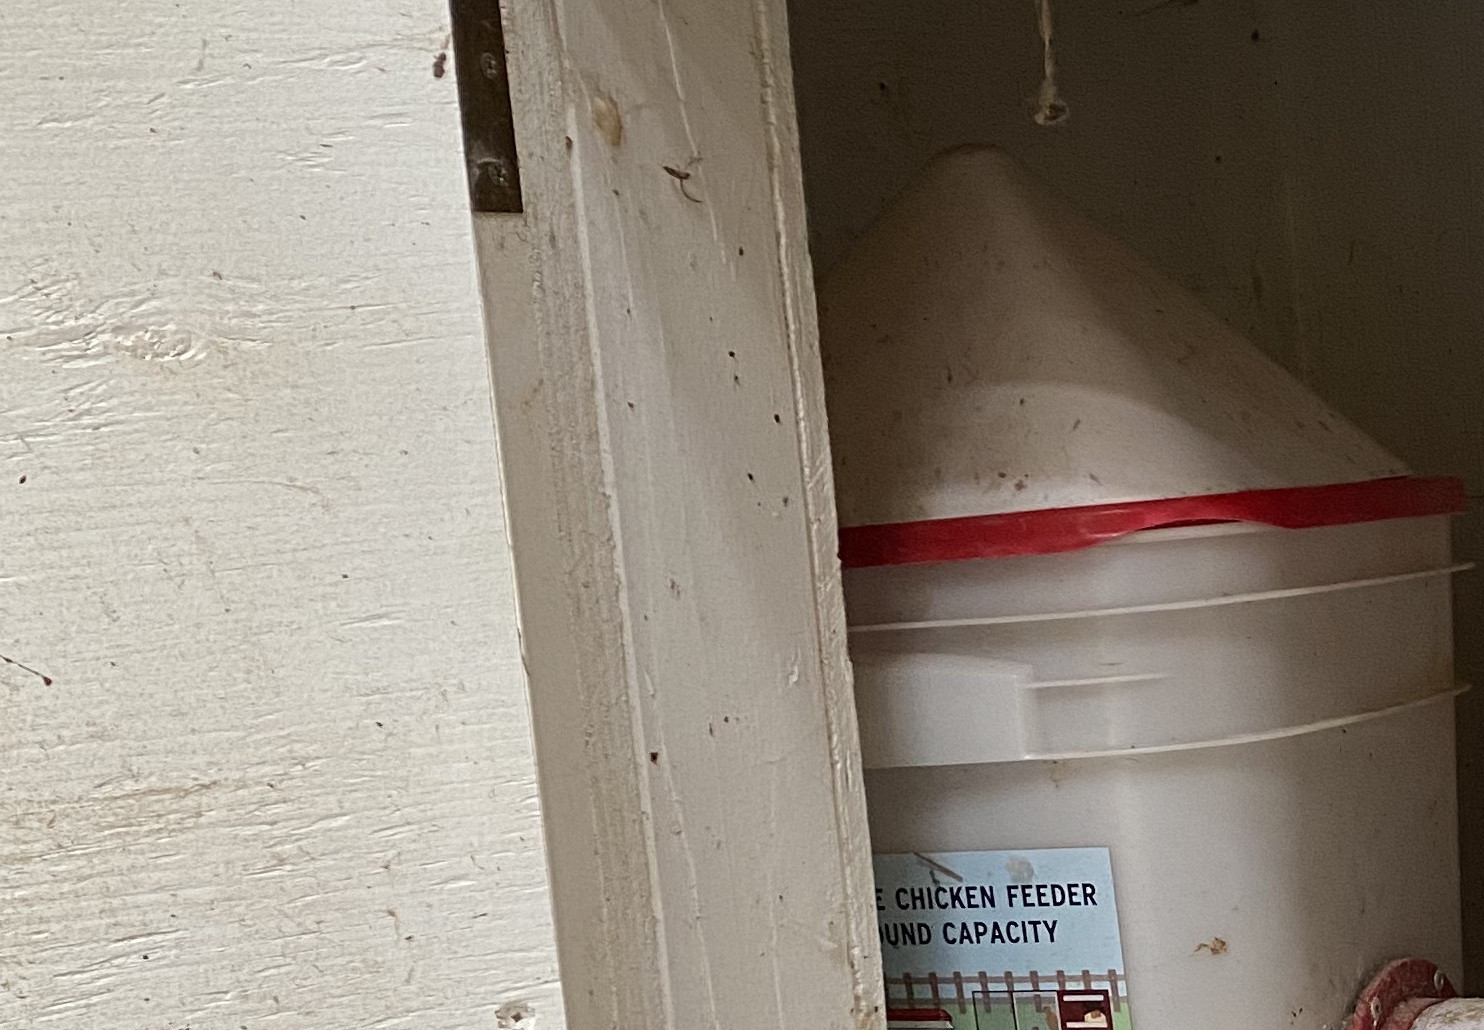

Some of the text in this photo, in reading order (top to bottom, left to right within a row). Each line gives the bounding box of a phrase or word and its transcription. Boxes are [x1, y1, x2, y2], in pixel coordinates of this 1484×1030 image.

[895, 886, 995, 911] CHICKEN
[1007, 883, 1098, 908] FEEDER
[943, 920, 1058, 945] CAPACITY
